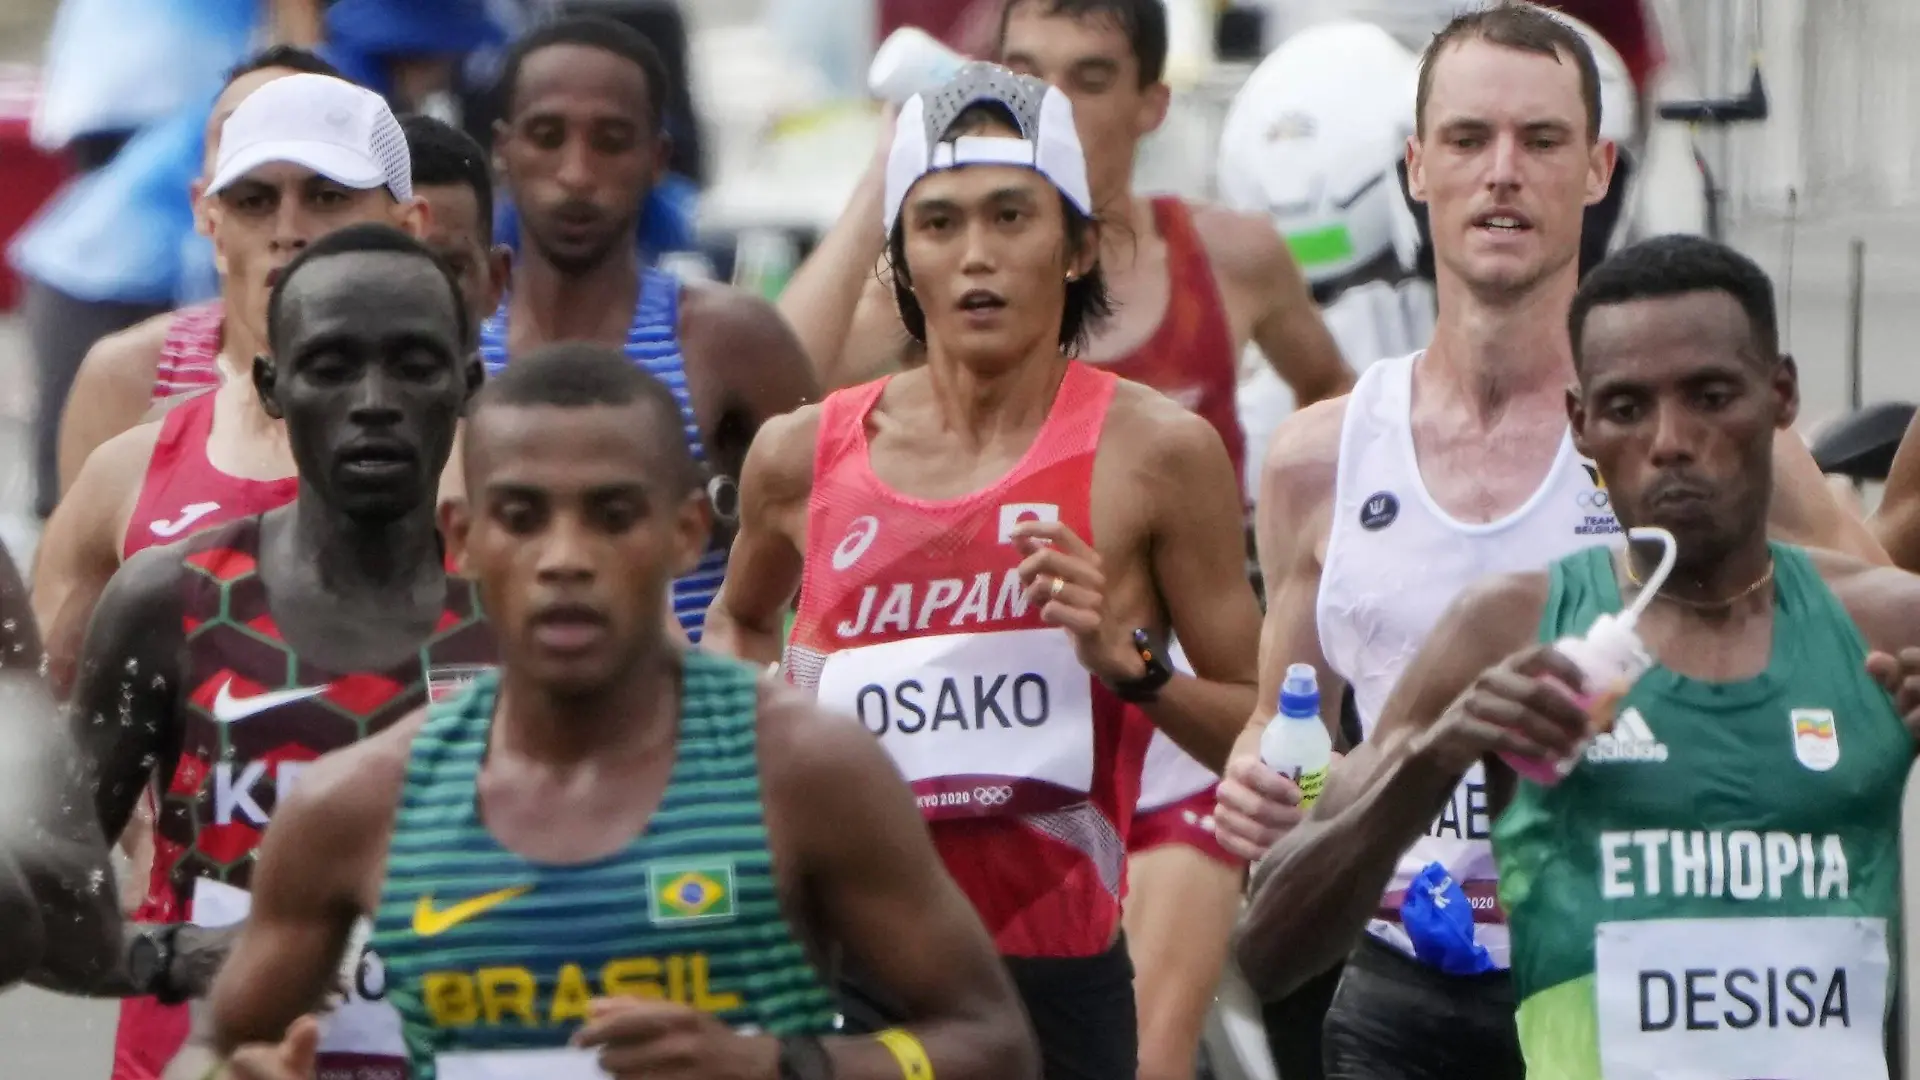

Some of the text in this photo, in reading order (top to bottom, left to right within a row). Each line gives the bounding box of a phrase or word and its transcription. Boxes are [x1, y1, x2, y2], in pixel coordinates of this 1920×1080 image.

[1584, 516, 1615, 526] TEAM
[837, 567, 1030, 638] JAPAN
[856, 672, 1050, 737] OSAKO
[940, 791, 970, 806] 2020
[1600, 829, 1849, 900] ETHIOPIA
[1466, 896, 1494, 909] 020
[423, 952, 743, 1029] BRASIL
[1638, 966, 1851, 1032] DESISA
